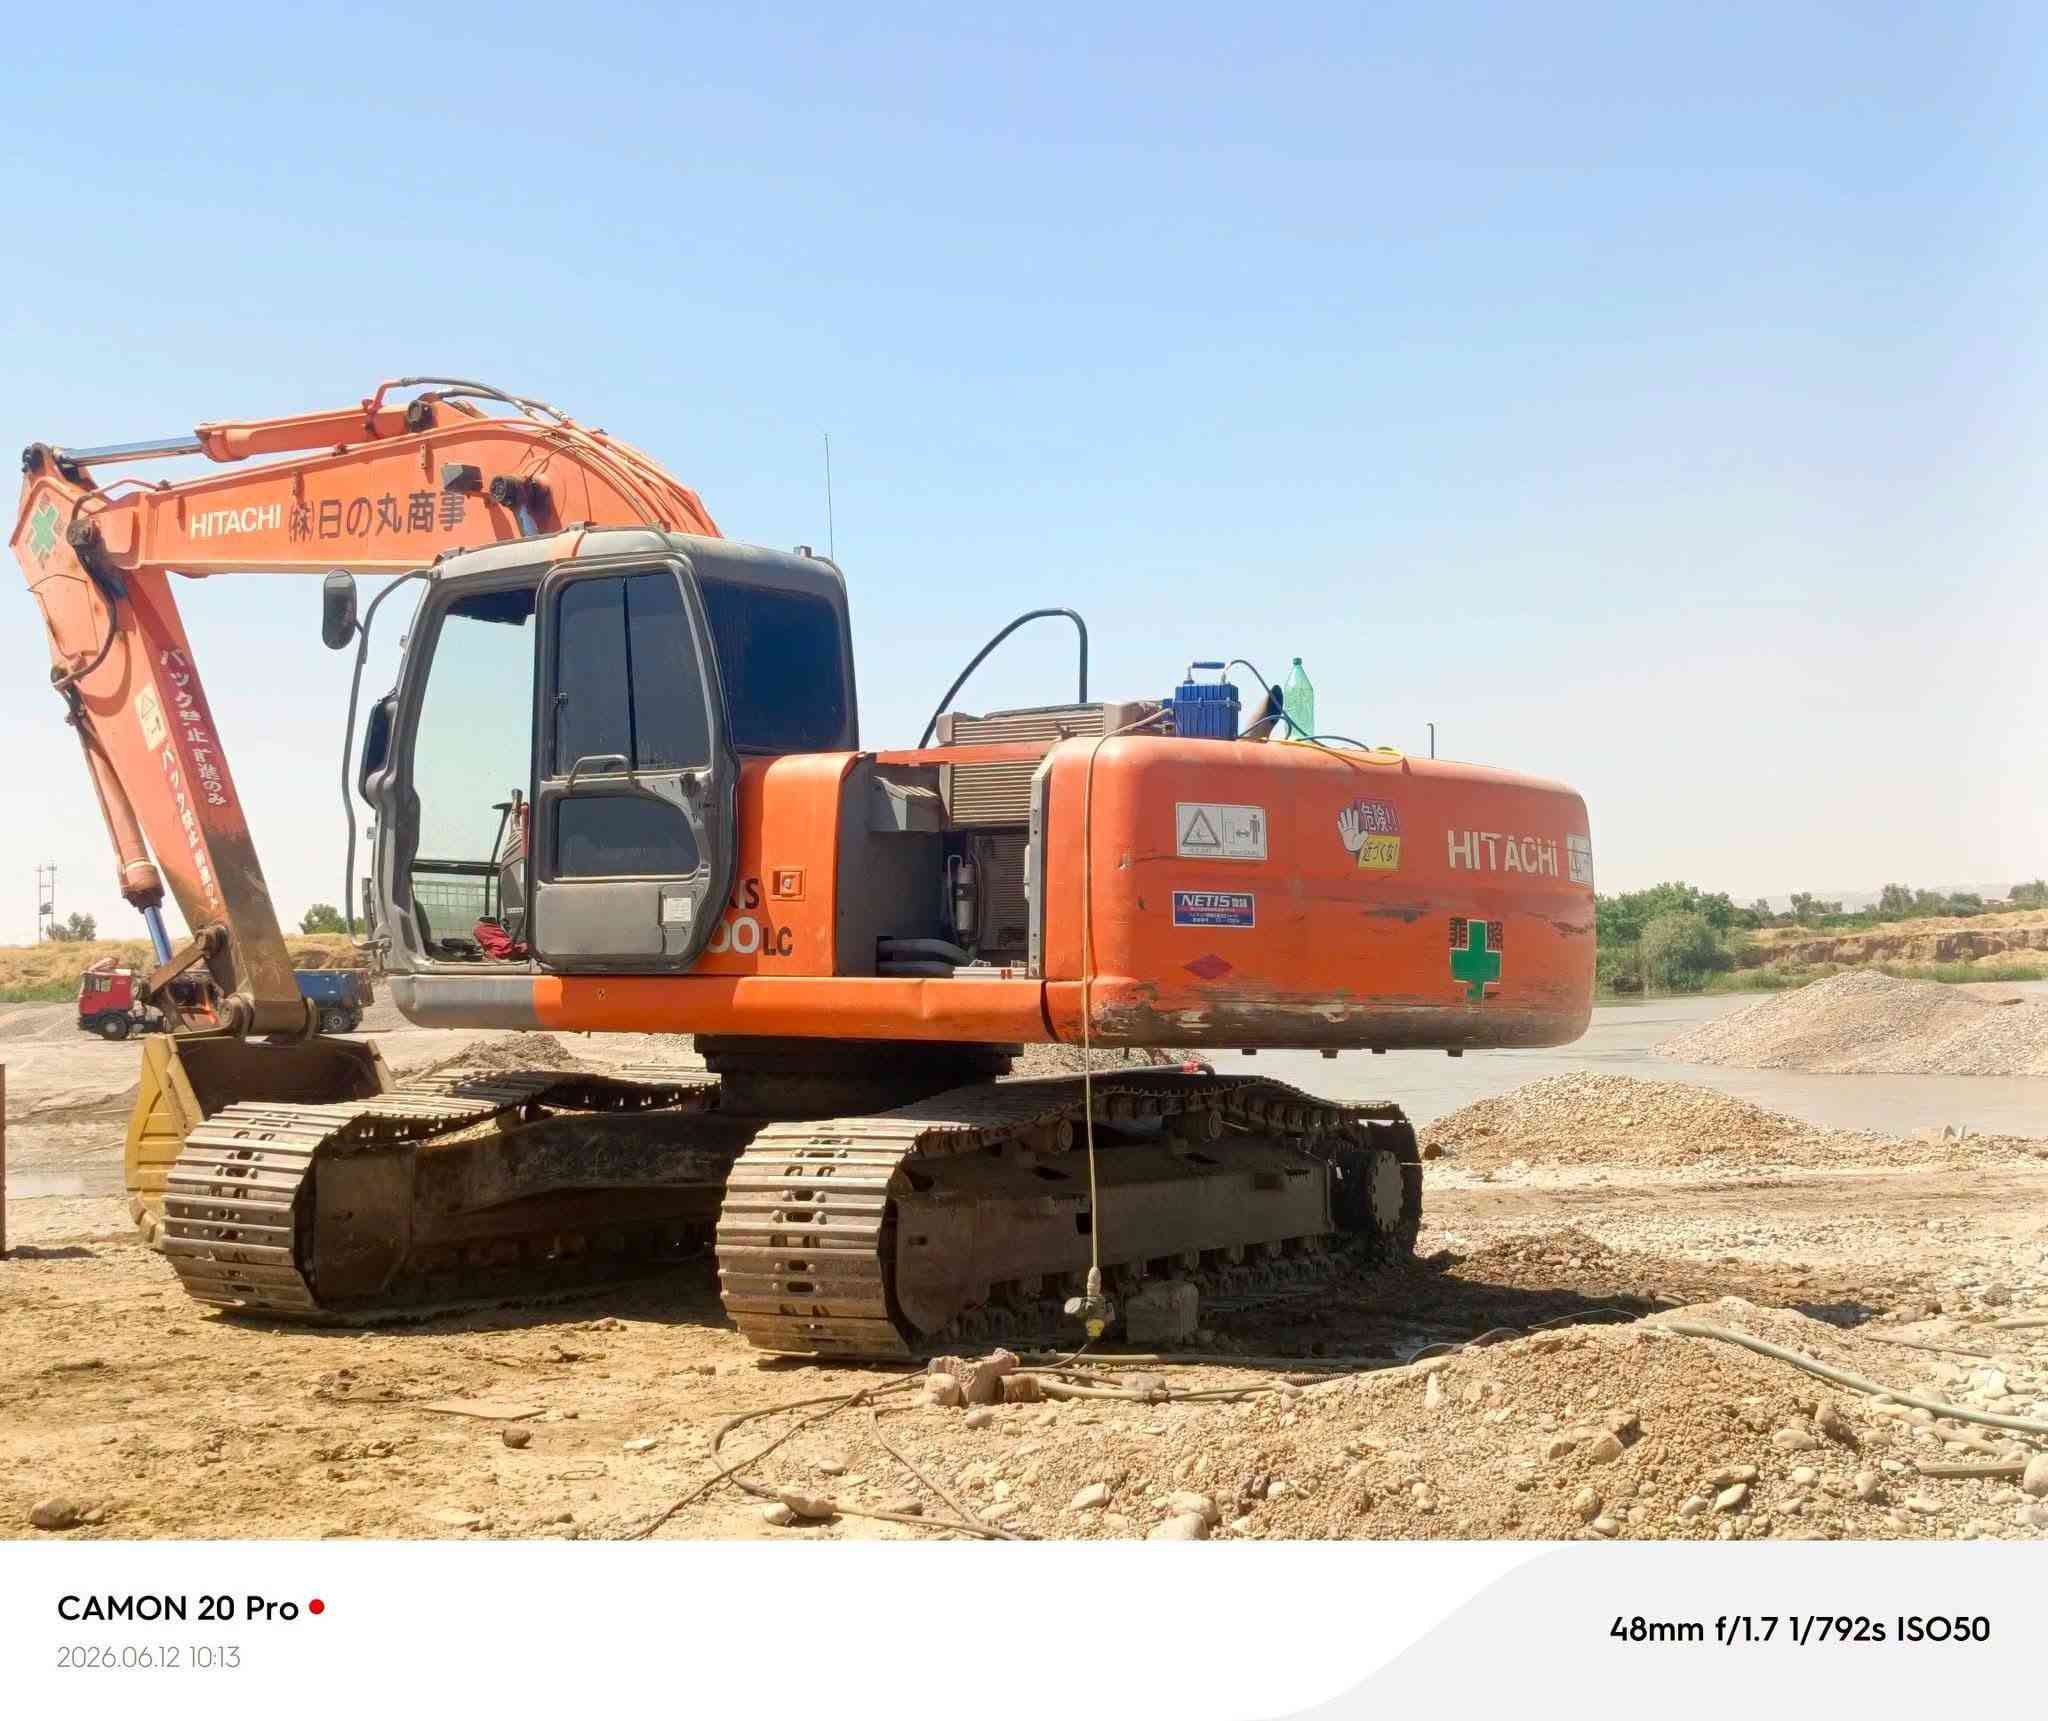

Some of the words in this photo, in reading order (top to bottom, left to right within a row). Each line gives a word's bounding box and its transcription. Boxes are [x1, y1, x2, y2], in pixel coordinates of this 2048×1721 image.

[190, 503, 282, 539] HITACHI
[1447, 829, 1559, 878] HITACHI
[1181, 894, 1231, 908] NETIS
